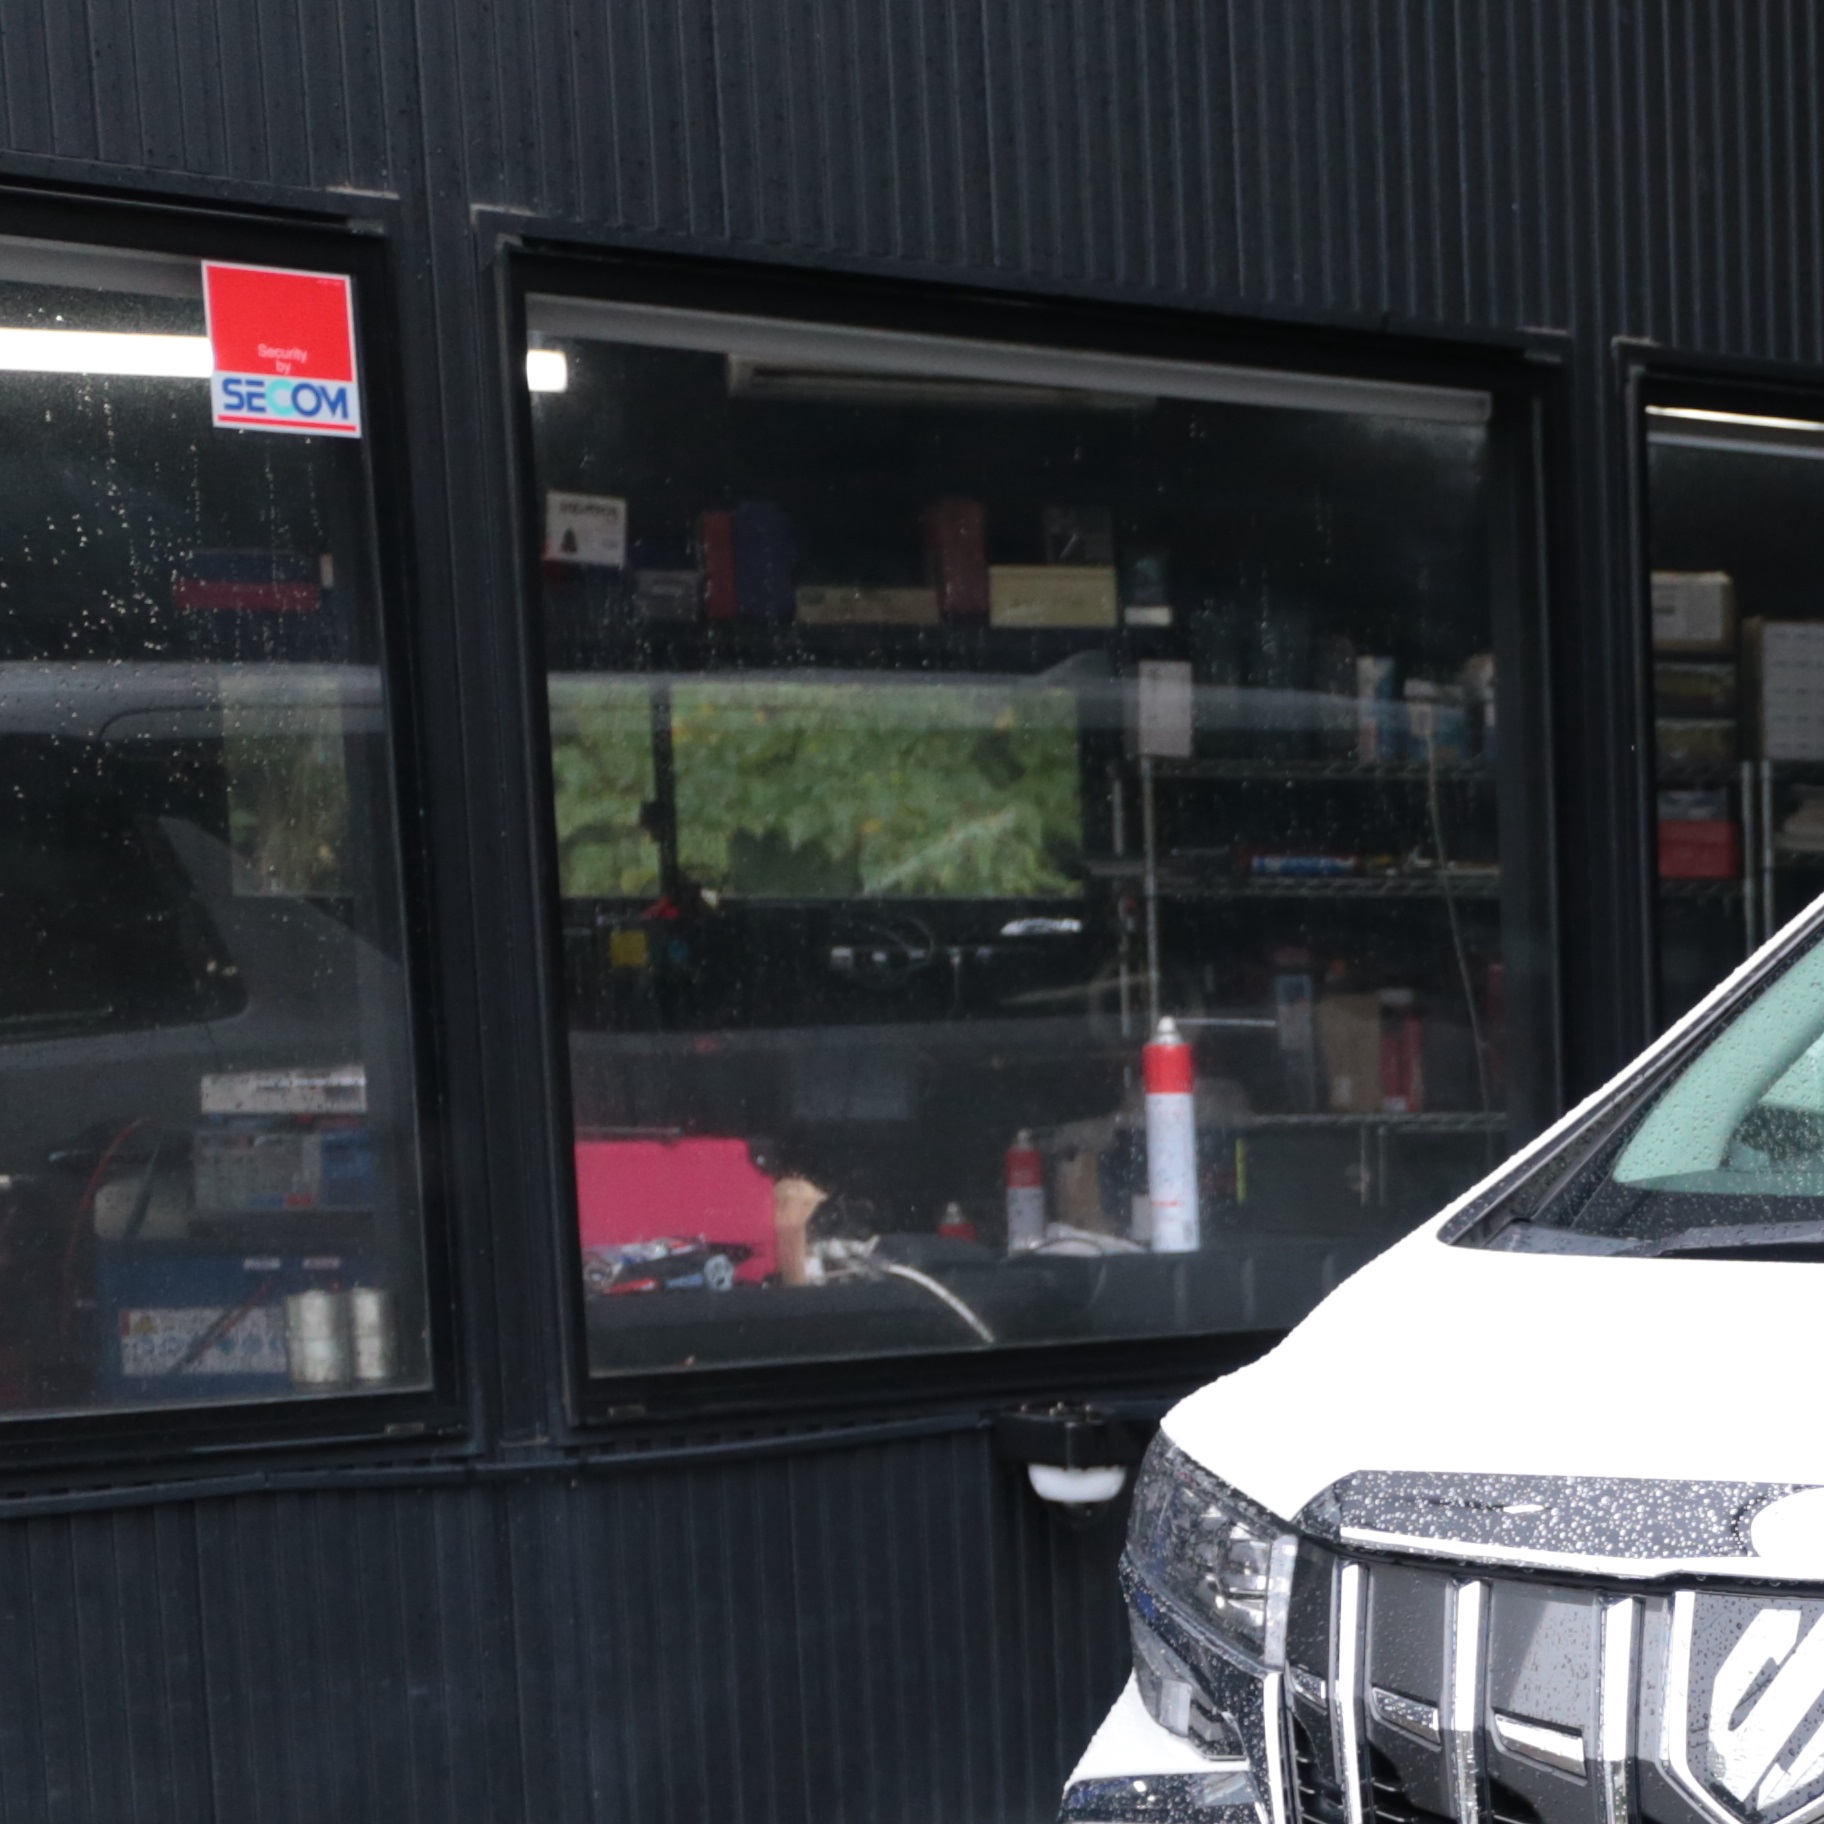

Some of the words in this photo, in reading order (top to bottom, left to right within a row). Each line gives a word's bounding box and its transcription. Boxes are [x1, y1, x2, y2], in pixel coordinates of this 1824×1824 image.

[257, 343, 308, 363] Security
[275, 360, 292, 376] by
[222, 377, 349, 420] SECOM
